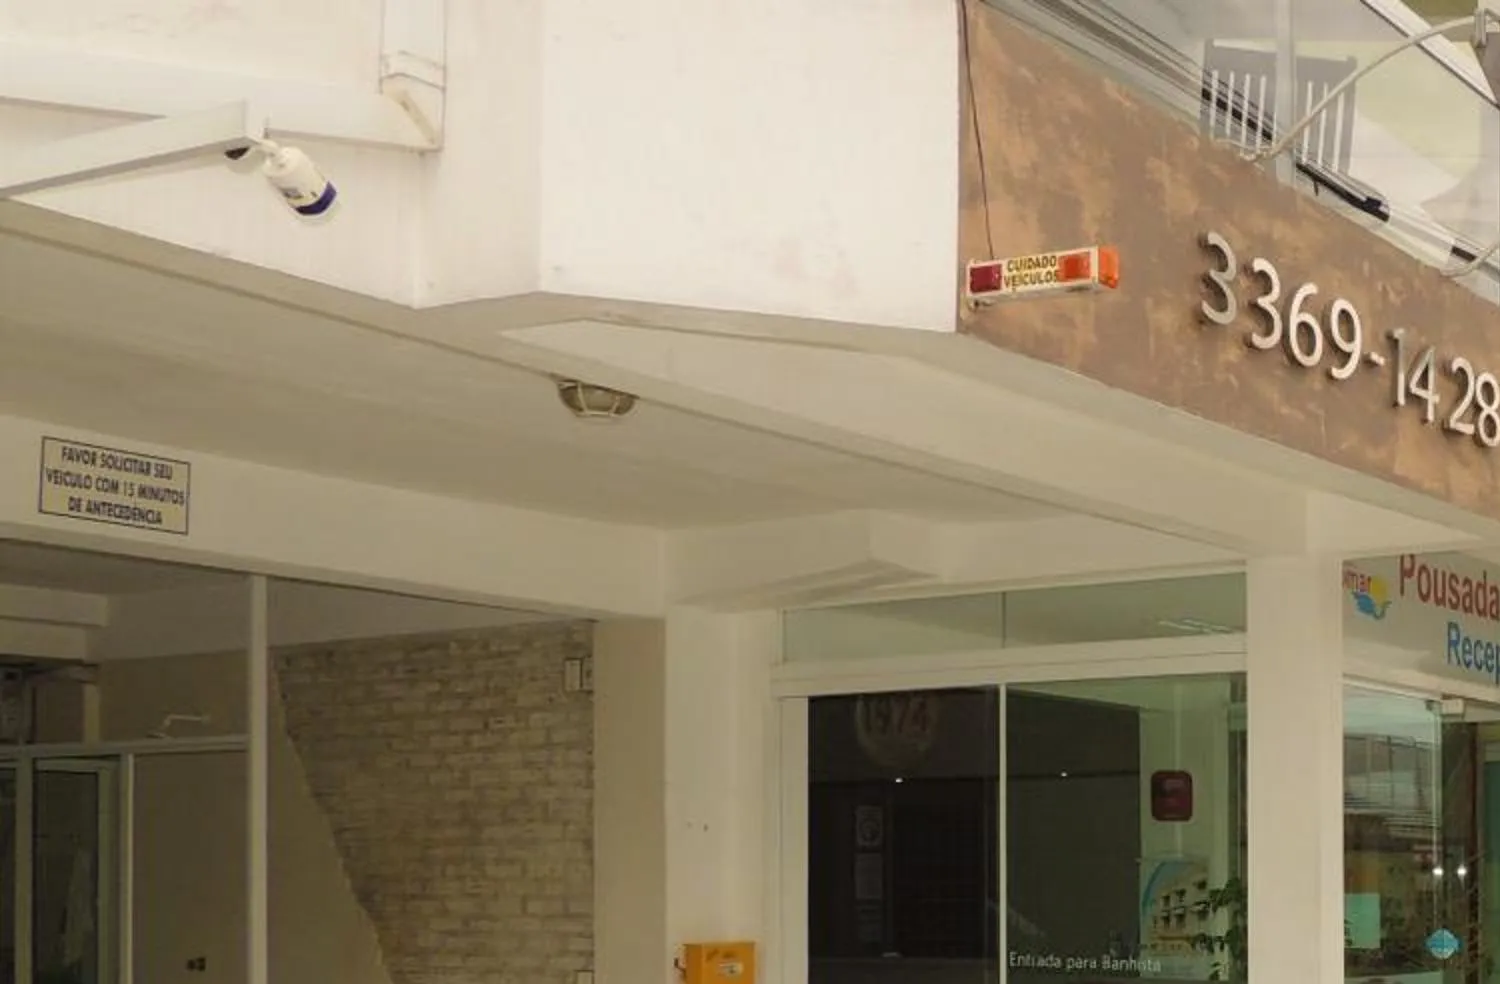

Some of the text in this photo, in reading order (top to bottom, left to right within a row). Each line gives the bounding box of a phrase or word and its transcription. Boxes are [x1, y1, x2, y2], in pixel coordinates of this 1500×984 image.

[1007, 255, 1057, 273] CUIDADO
[61, 445, 174, 481] FAVOR SOLICITAR SEU
[96, 475, 120, 495] COM
[123, 480, 135, 498] 15
[137, 483, 186, 506] MINUTOS
[67, 495, 83, 513] DE
[1399, 553, 1500, 623] Pousada
[1008, 950, 1062, 970] Entrada
[1065, 956, 1098, 972] para
